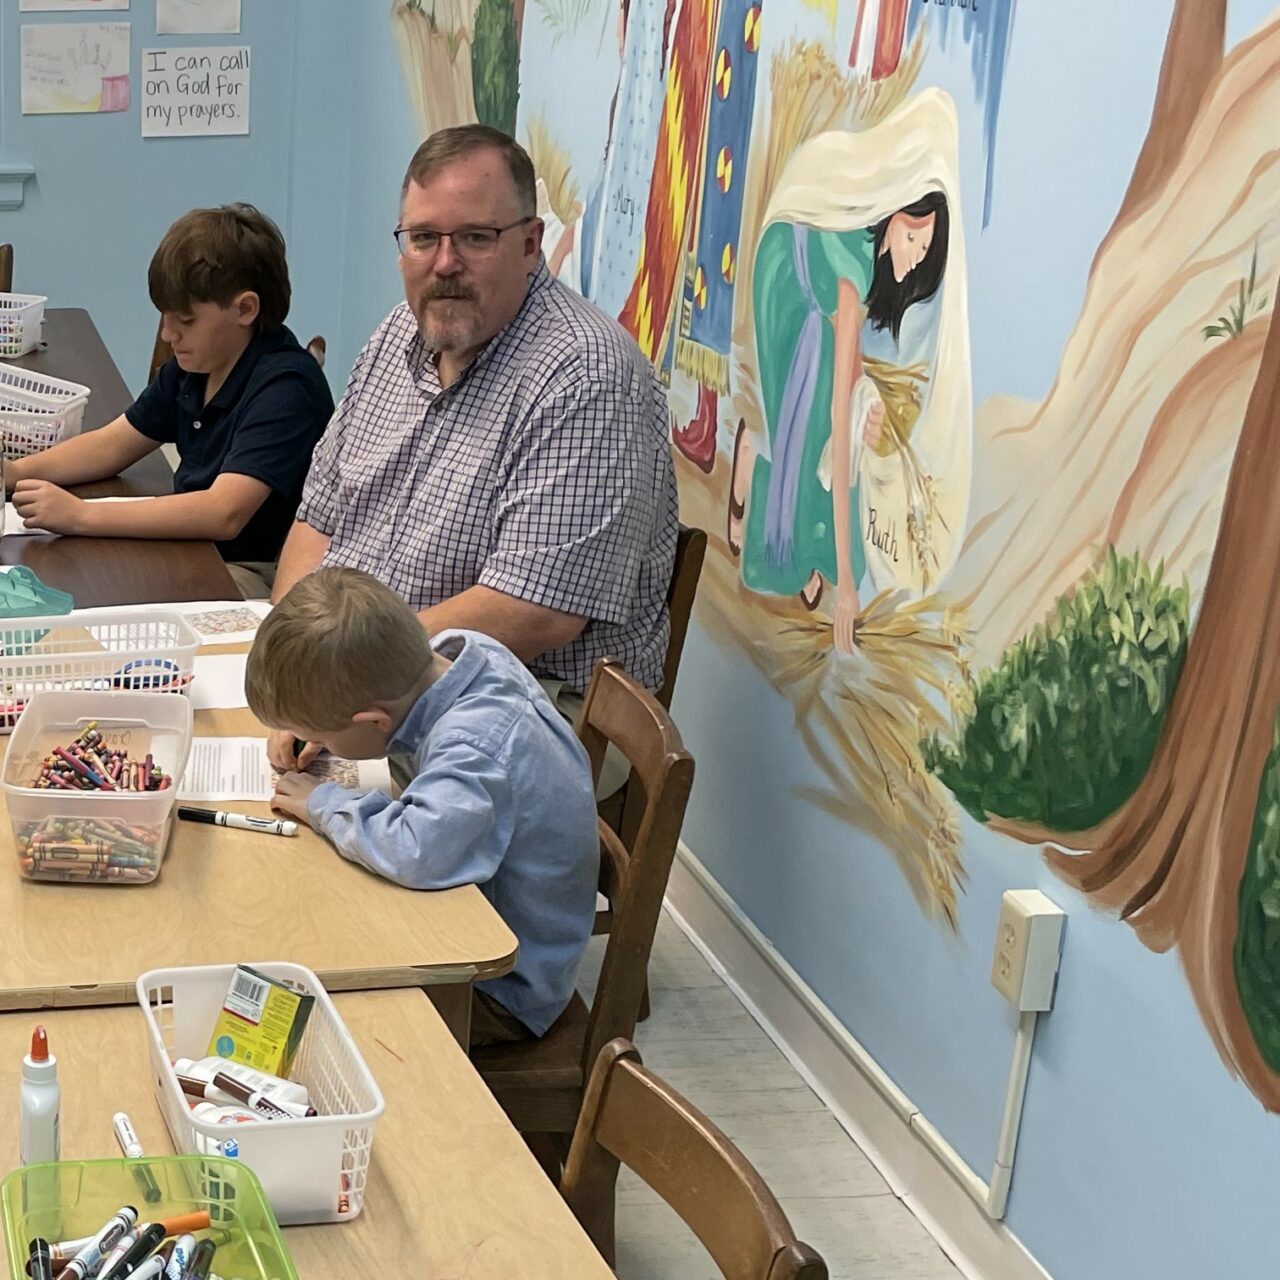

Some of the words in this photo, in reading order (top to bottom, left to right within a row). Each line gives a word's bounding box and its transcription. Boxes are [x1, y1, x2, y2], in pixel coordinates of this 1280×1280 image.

[146, 51, 168, 73] I
[174, 55, 212, 72] can
[219, 50, 250, 71] call
[146, 78, 170, 96] on
[176, 73, 210, 96] God
[215, 75, 243, 97] for
[146, 104, 172, 127] my
[178, 102, 241, 127] prayers.
[865, 507, 900, 563] Ruth
